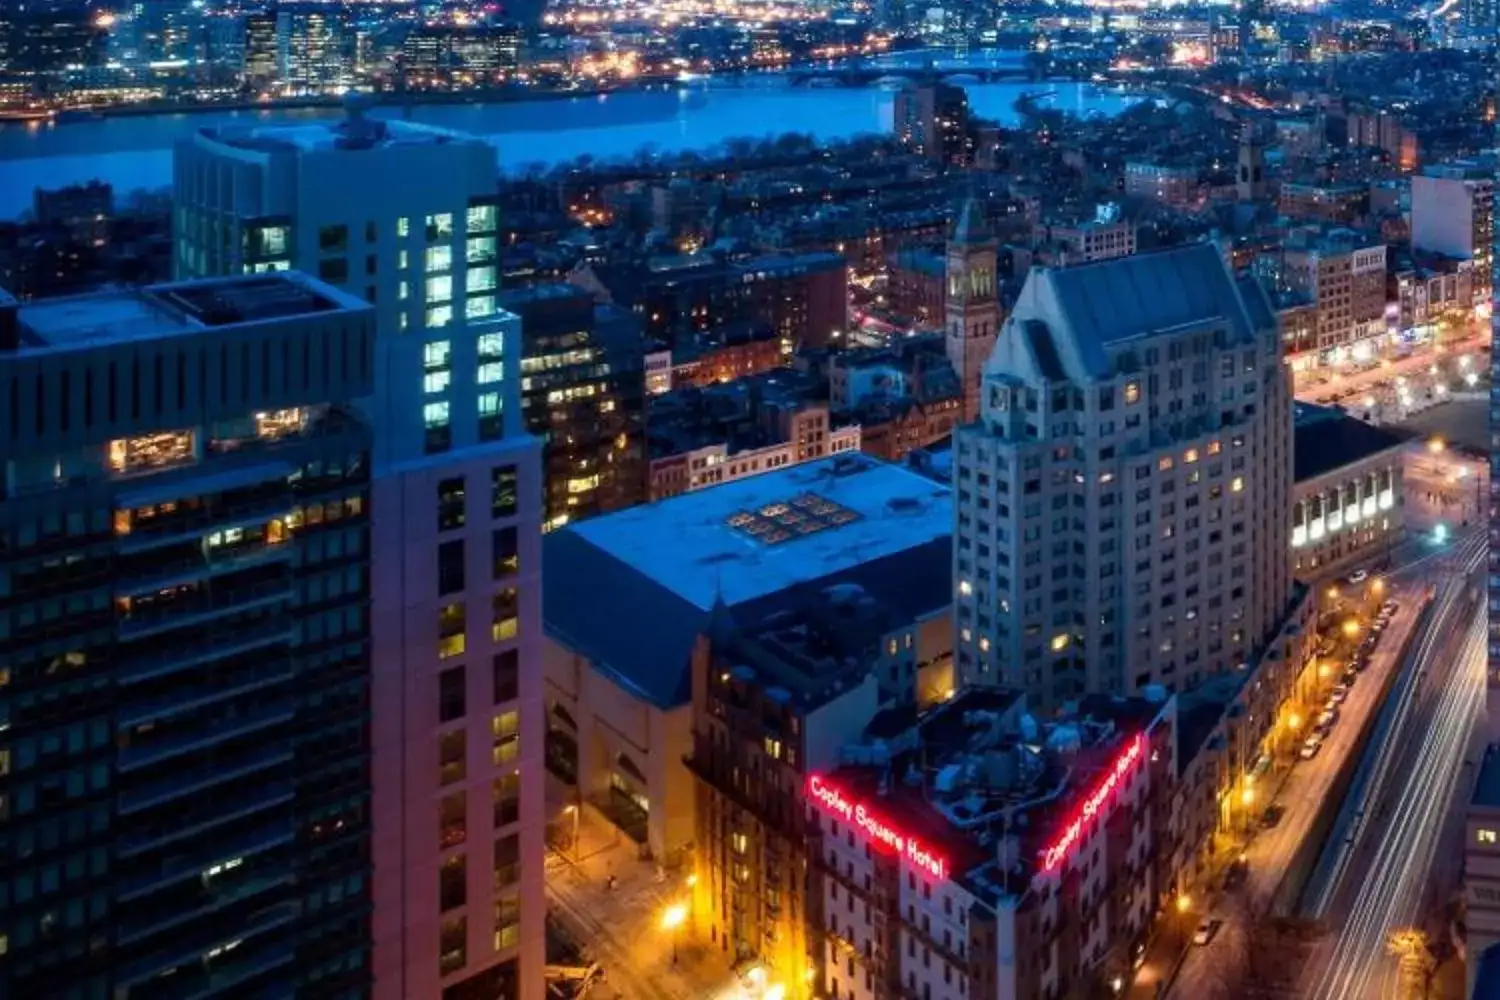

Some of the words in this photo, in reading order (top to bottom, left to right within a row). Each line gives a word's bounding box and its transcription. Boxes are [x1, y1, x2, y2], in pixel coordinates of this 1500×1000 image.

[811, 776, 852, 820] Copley
[855, 804, 903, 851] Square
[907, 838, 943, 879] Hotel
[1045, 815, 1081, 871] Copley
[1082, 772, 1116, 823] Square
